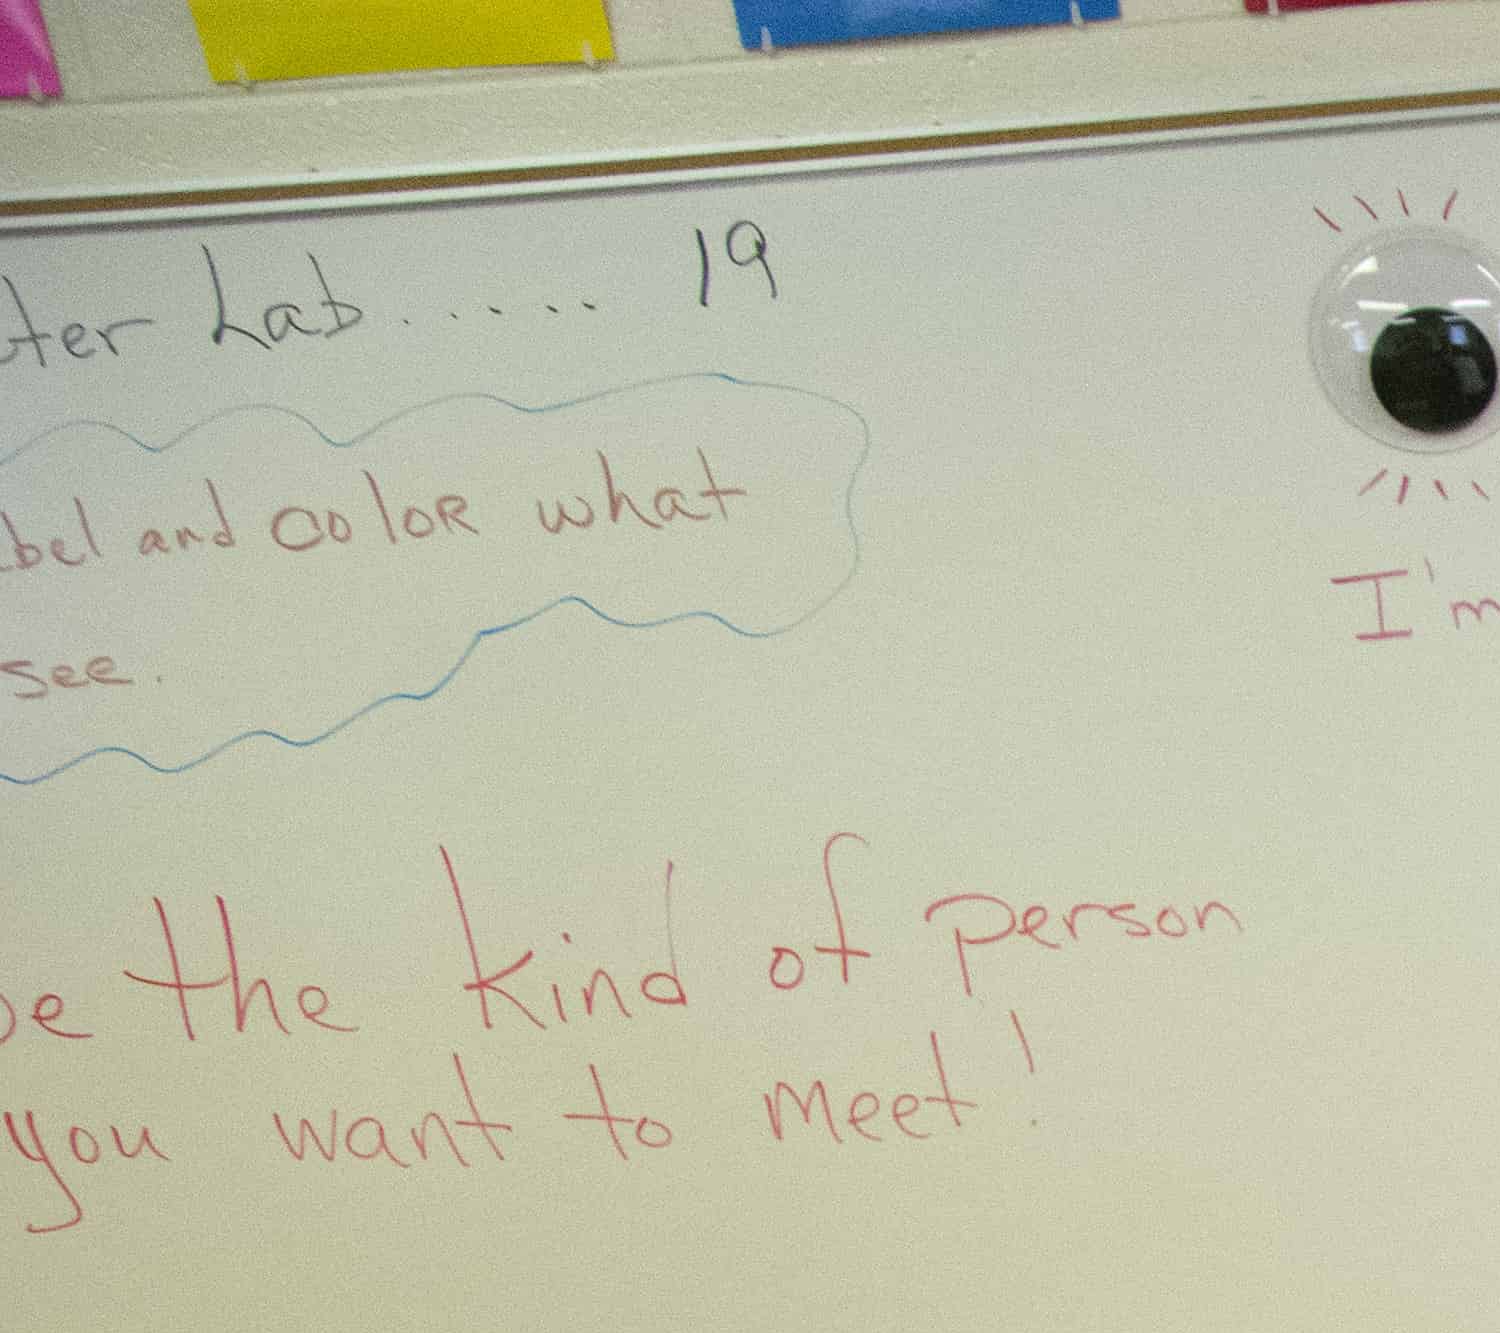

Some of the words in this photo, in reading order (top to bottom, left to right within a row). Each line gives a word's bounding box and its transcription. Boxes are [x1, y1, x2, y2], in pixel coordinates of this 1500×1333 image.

[0, 275, 152, 367] ter
[695, 219, 779, 308] 19
[0, 497, 103, 568] bel
[139, 480, 235, 556] and
[539, 449, 747, 535] what
[126, 895, 359, 1041] the
[440, 844, 689, 1031] kind
[768, 831, 872, 992] of
[925, 891, 1245, 998] person
[3, 1111, 169, 1233] you
[272, 1052, 513, 1169] want
[564, 1064, 673, 1160] to
